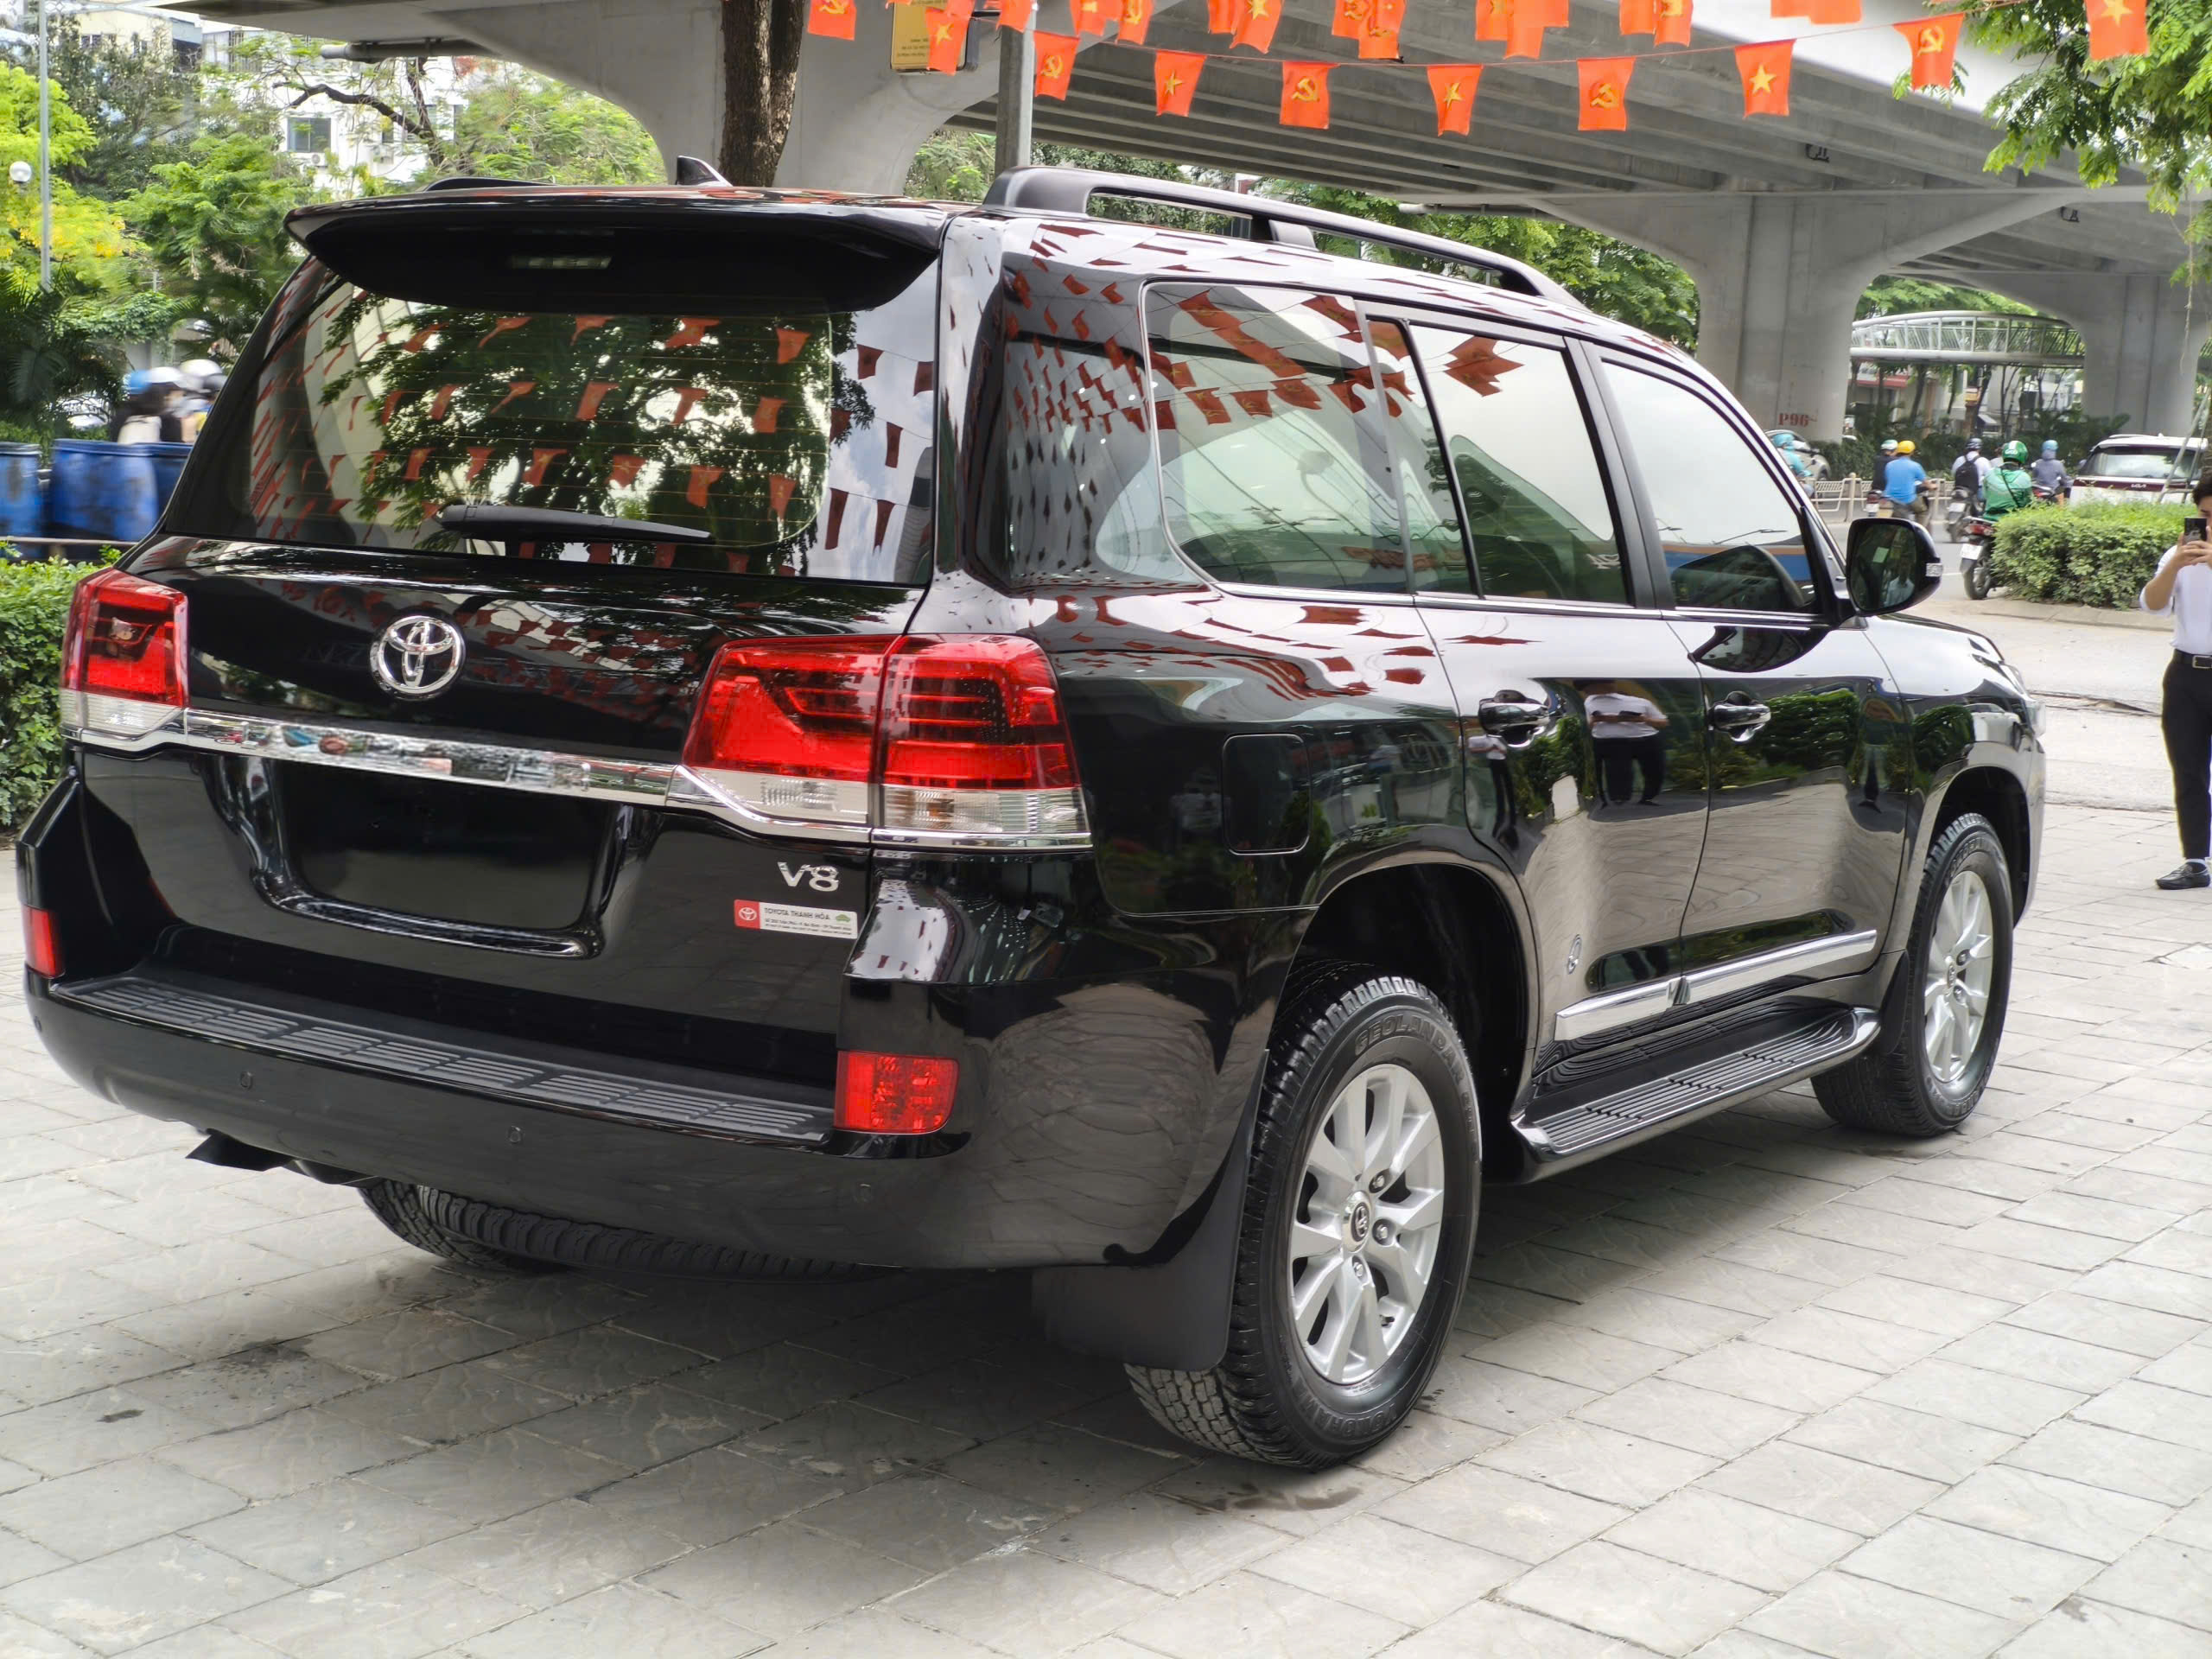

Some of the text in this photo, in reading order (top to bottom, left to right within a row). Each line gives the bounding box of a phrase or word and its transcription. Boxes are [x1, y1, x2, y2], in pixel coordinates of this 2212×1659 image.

[1778, 413, 1809, 427] P96
[777, 861, 840, 892] V8
[764, 907, 790, 916] TOYOTA
